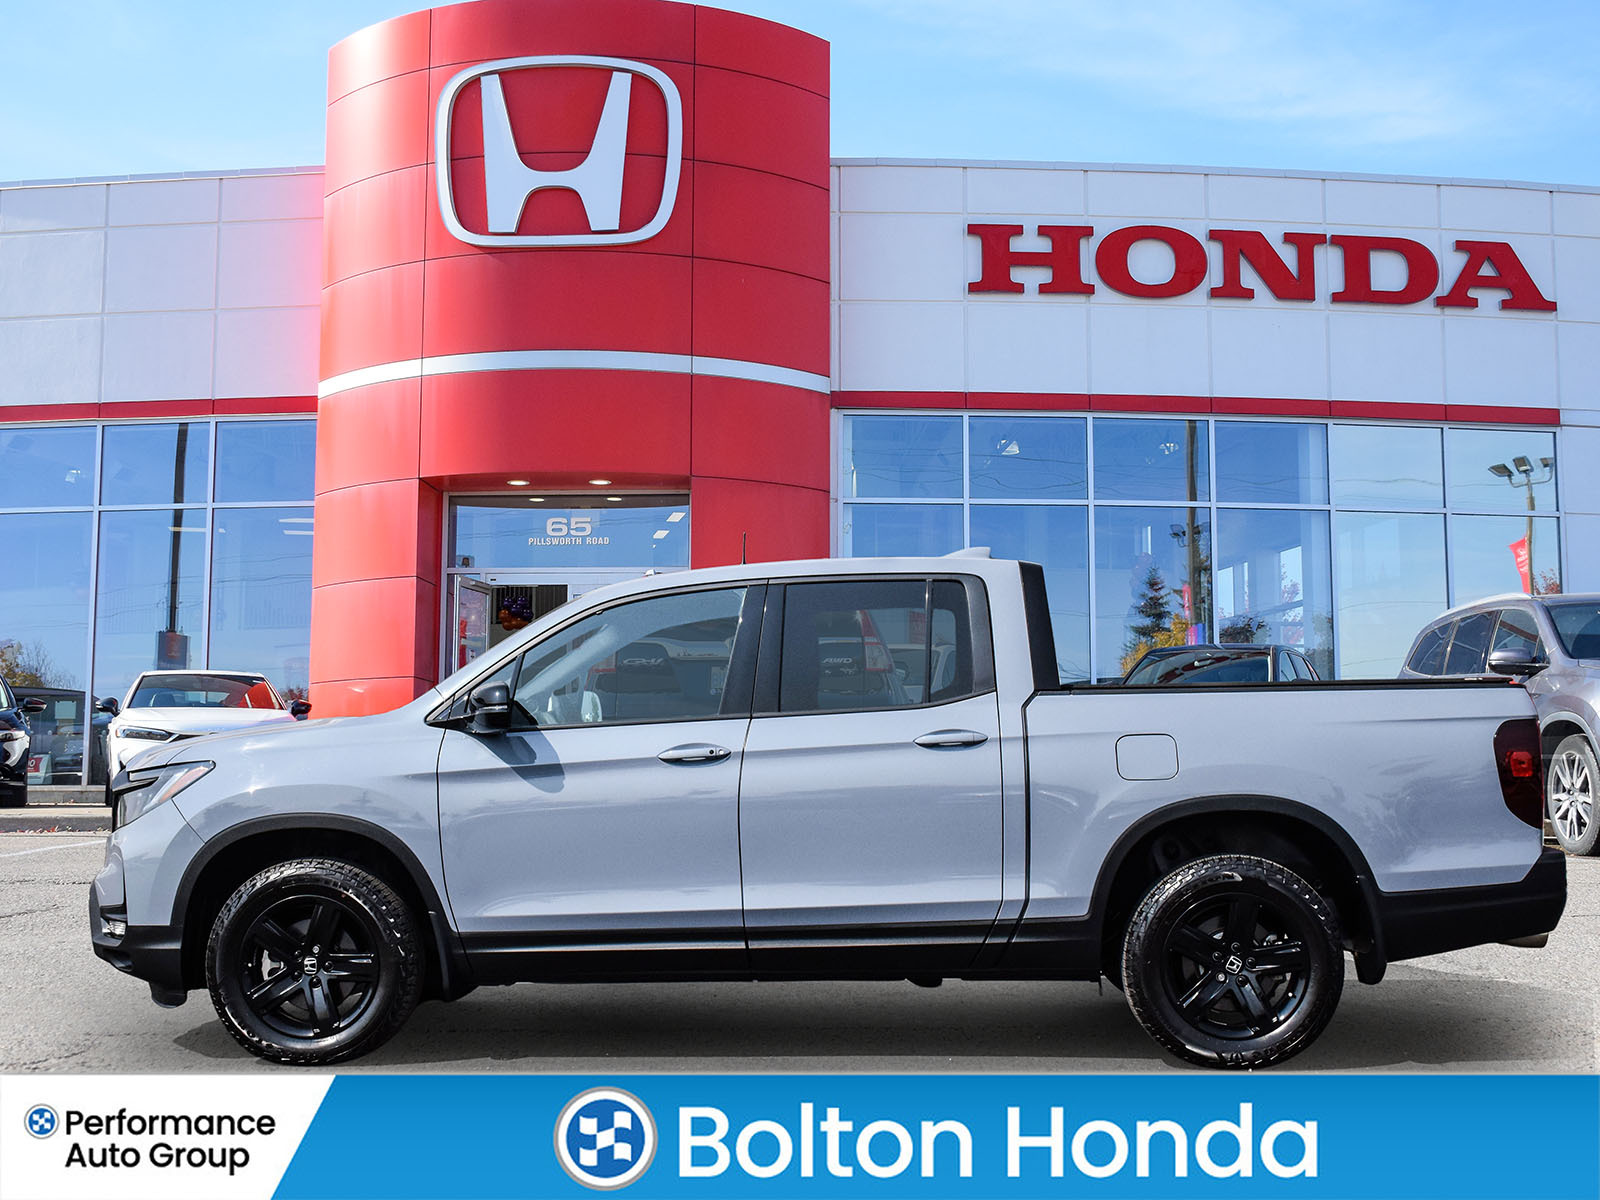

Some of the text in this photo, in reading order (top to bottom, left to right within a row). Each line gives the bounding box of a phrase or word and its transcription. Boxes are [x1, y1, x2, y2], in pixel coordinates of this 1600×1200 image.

[967, 224, 1558, 312] HONDA
[545, 517, 592, 537] 65
[527, 536, 610, 546] PILLSWORTH ROAD
